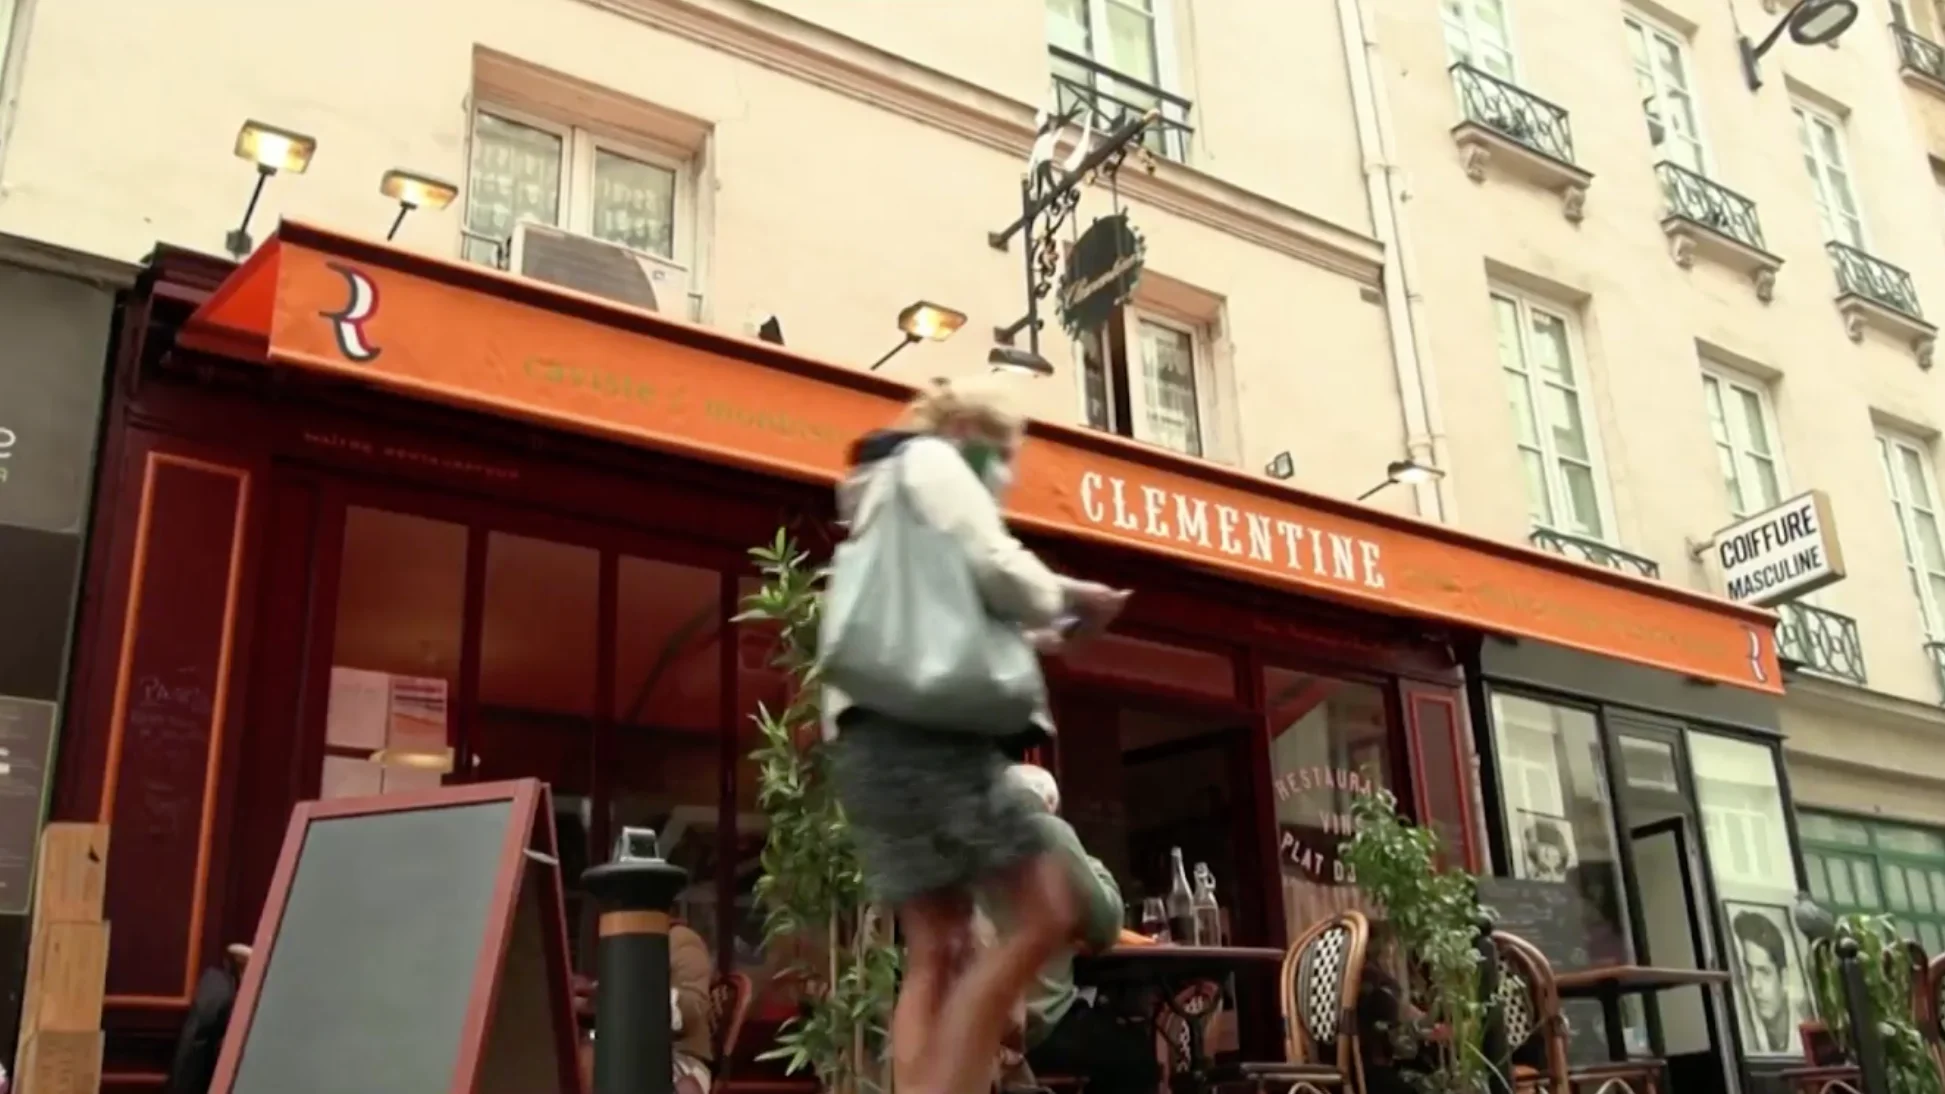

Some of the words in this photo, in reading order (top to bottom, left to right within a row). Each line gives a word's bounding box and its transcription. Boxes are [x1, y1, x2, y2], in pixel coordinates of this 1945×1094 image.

[1080, 471, 1386, 589] CLEMENTINE
[1720, 506, 1816, 569] COIFFURE
[1728, 546, 1822, 600] MASCULINE
[1275, 767, 1371, 801] RESTAURA
[1281, 832, 1324, 874] PLAT
